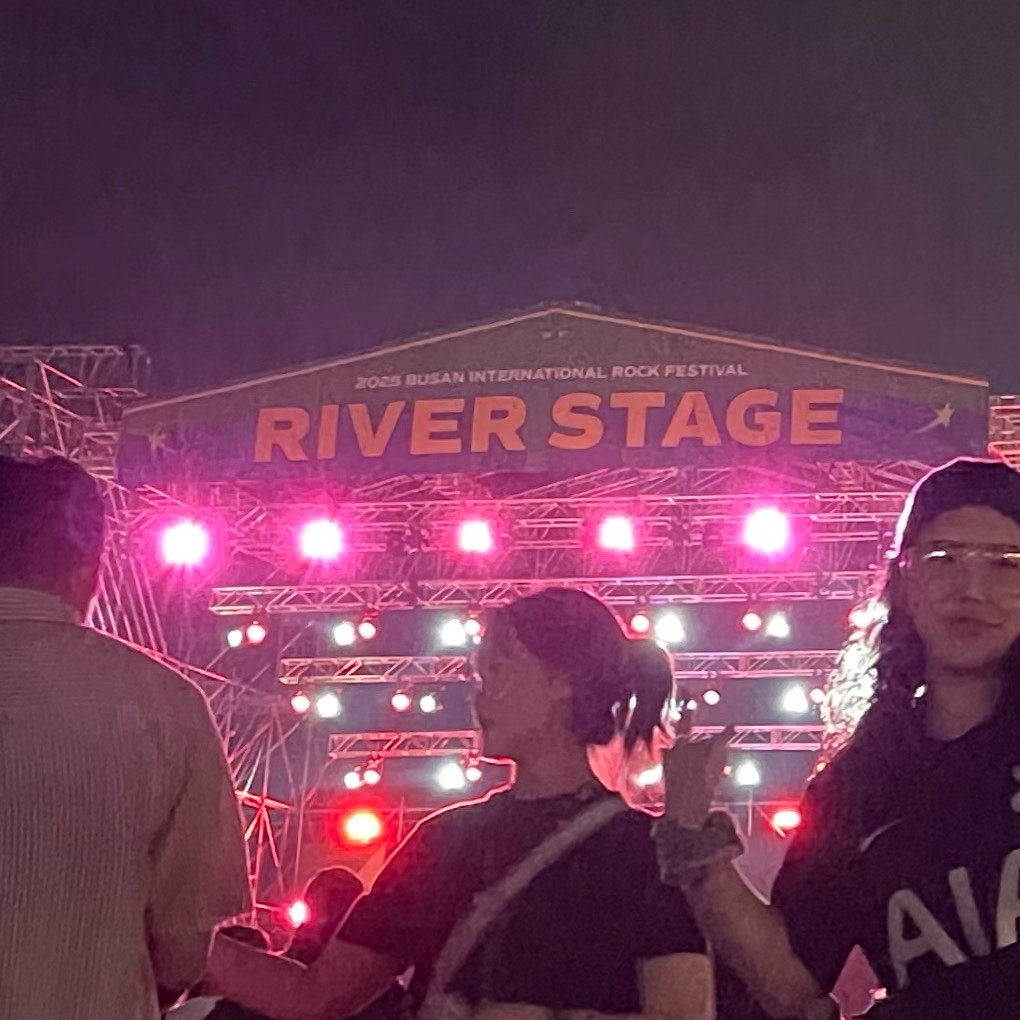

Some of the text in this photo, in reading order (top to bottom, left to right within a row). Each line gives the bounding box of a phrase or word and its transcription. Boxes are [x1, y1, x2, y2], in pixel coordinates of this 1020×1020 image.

[355, 363, 749, 390] 2025 BUSAN INTERNATIONAL ROCK FESTIVAL
[254, 389, 844, 462] RIVER STAGE
